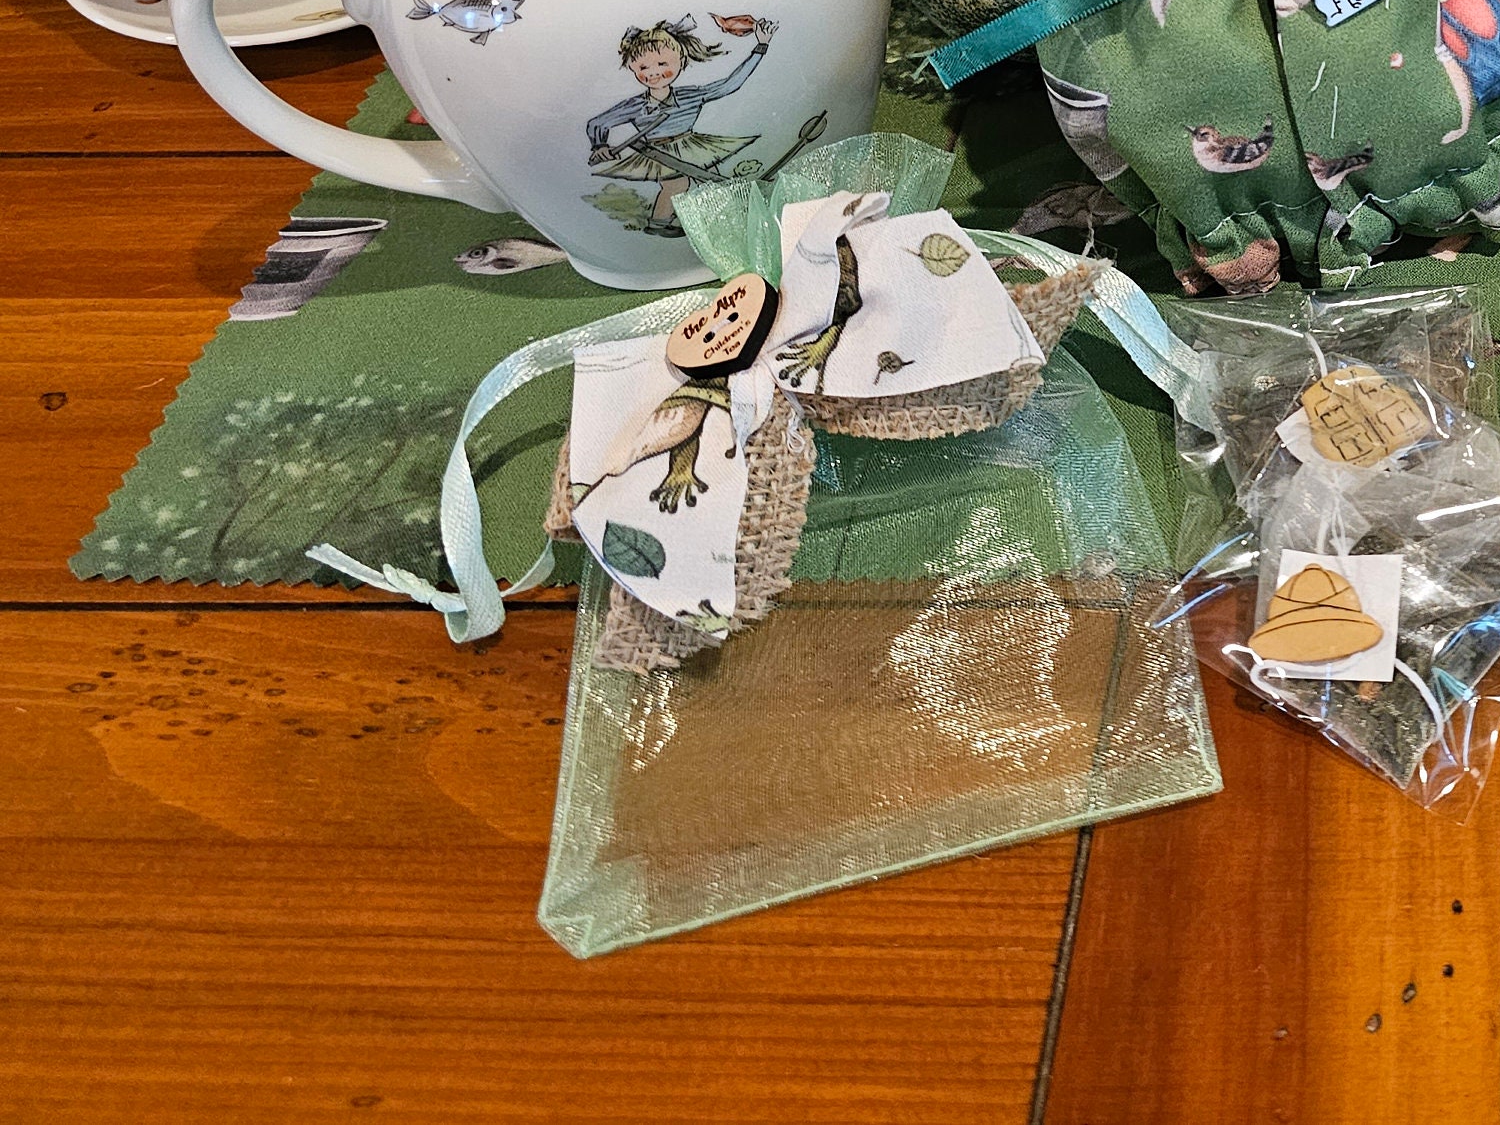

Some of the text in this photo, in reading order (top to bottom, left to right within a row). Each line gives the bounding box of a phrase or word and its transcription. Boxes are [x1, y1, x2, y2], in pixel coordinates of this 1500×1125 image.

[682, 284, 748, 340] the Alps
[703, 319, 751, 360] Children's
[722, 340, 741, 356] Tea
